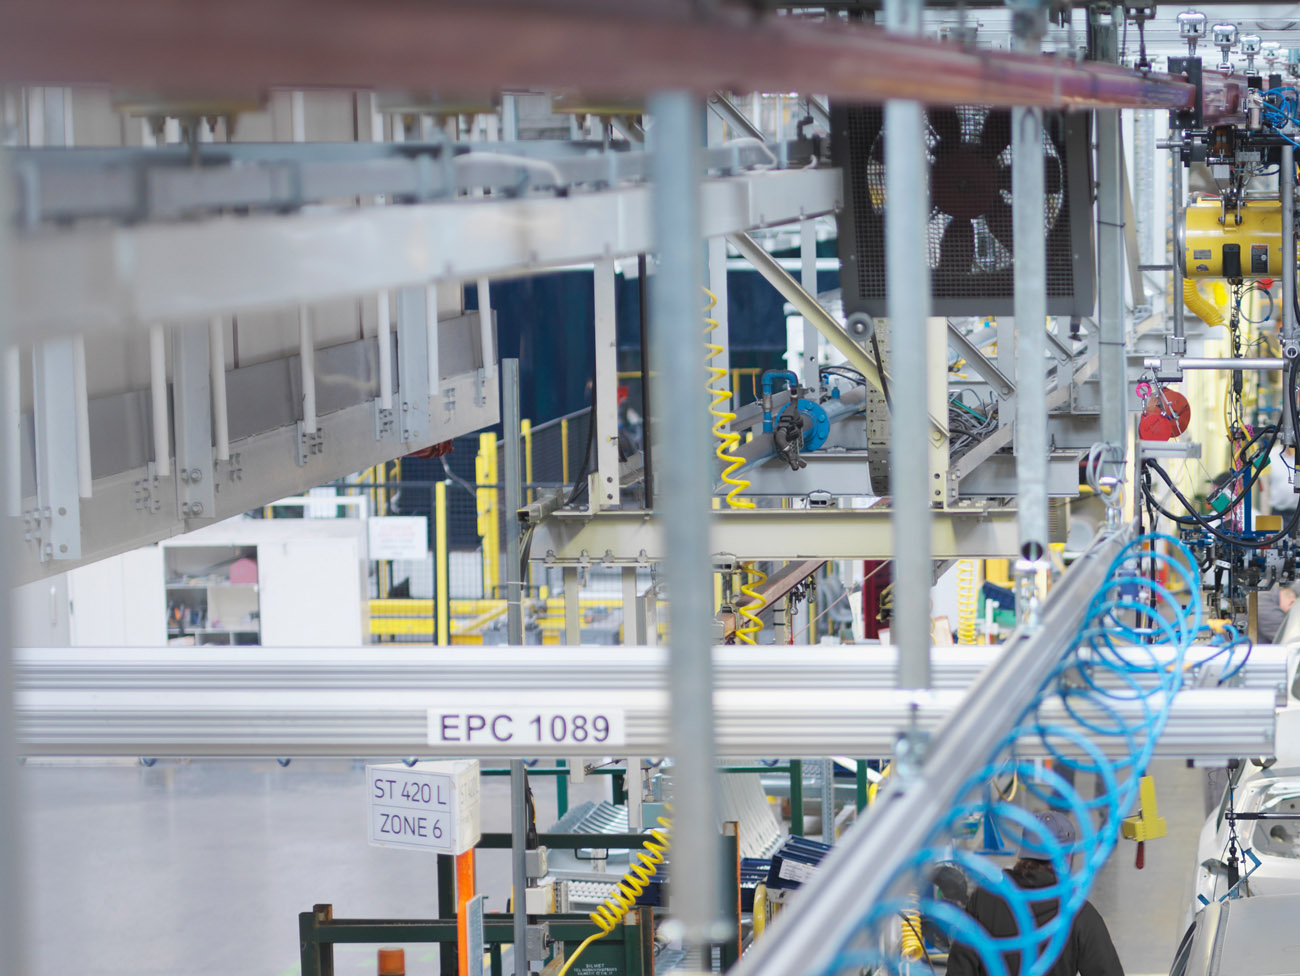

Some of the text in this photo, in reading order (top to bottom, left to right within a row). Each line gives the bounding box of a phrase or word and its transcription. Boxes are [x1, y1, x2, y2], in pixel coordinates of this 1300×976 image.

[440, 713, 610, 742] EPC 1089
[374, 778, 397, 799] ST
[400, 782, 432, 803] 420
[437, 784, 447, 805] L
[380, 813, 443, 839] ZONE 6
